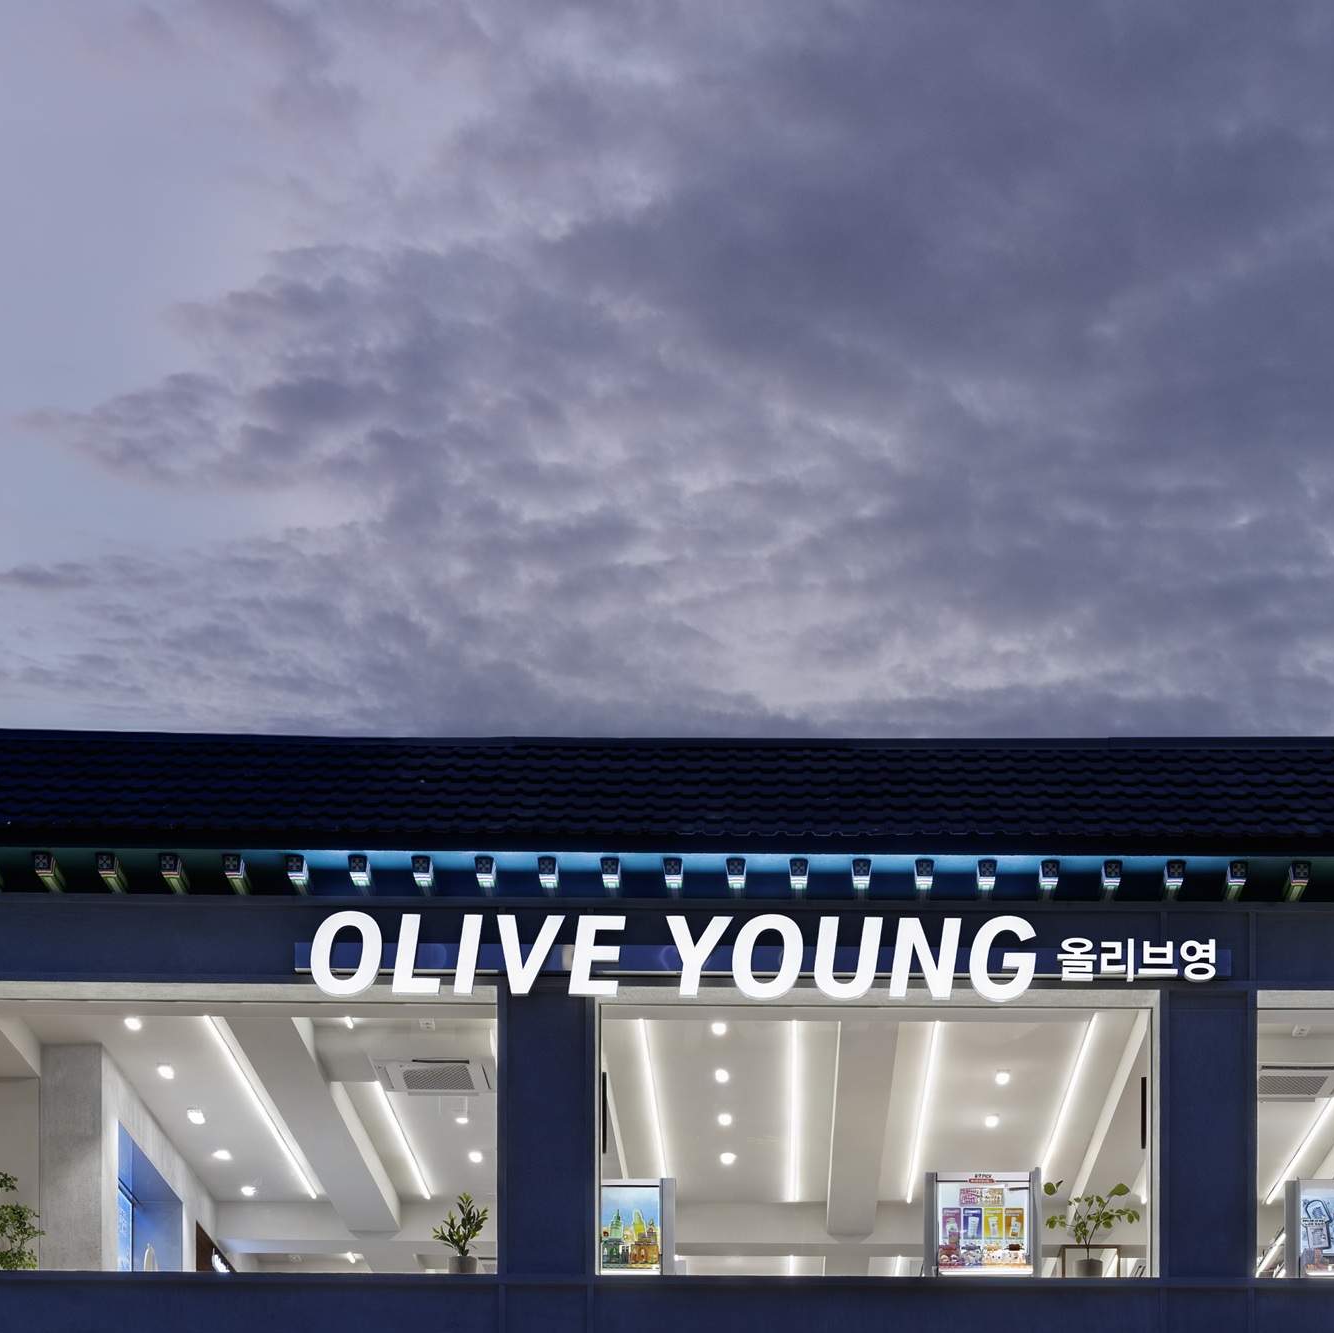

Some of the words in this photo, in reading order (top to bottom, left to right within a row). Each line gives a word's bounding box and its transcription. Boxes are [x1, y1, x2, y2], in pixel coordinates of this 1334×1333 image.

[309, 911, 627, 998] OLIVE
[666, 914, 1038, 1001] YOUNG
[1056, 936, 1218, 983] 올리브영
